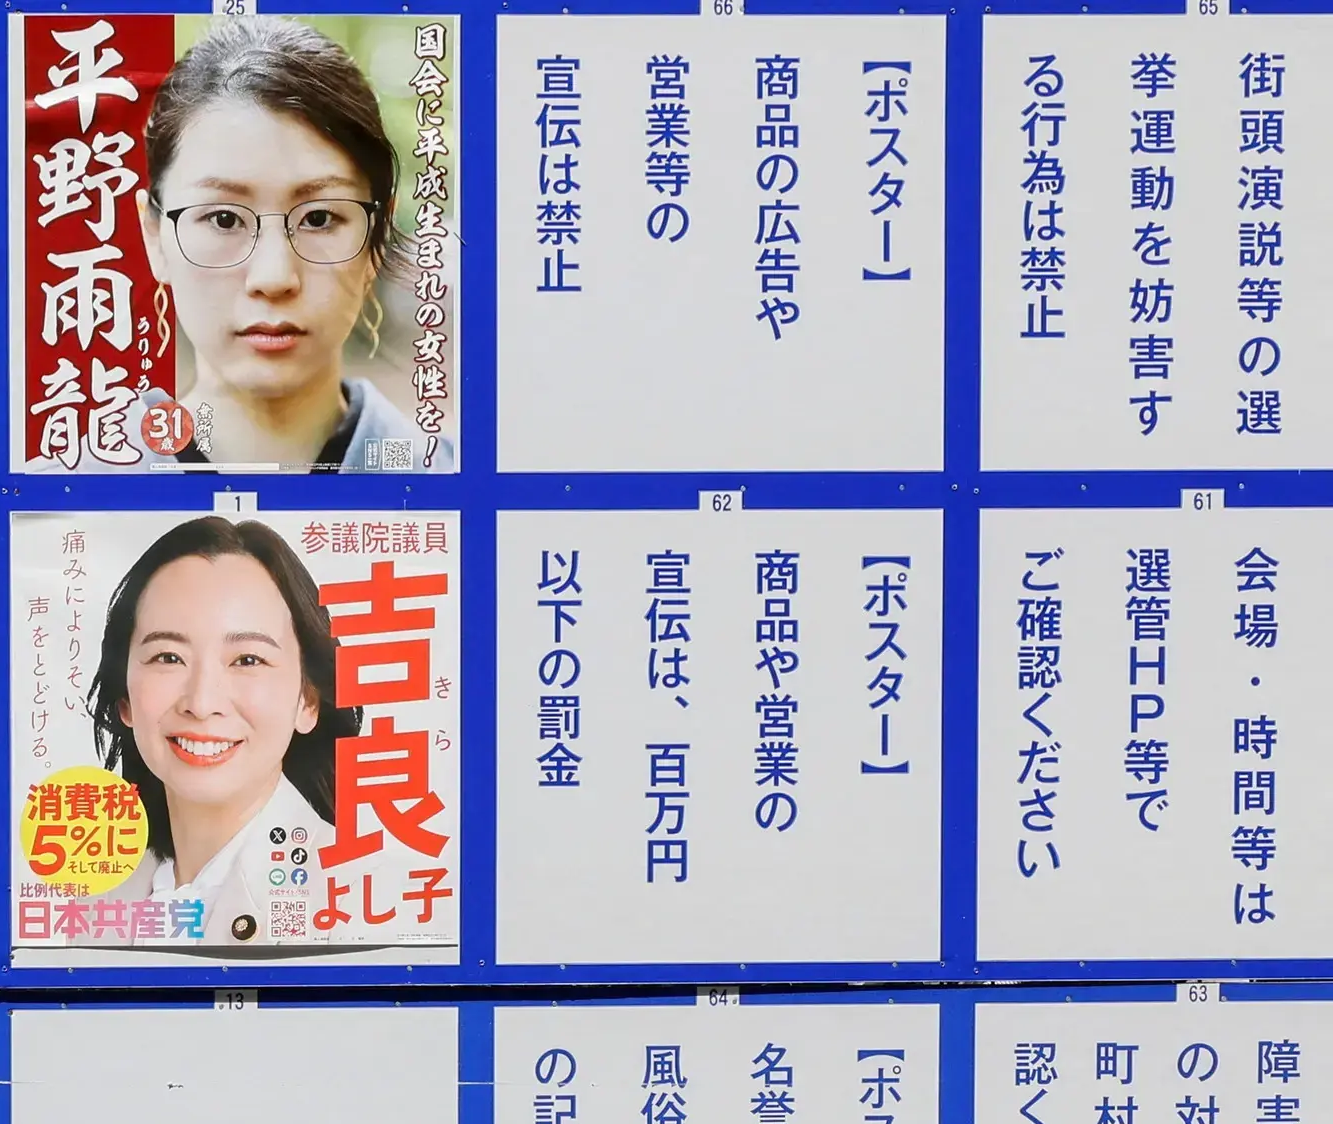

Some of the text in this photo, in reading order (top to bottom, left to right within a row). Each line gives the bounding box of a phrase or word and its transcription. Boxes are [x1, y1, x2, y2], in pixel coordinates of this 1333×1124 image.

[226, 0, 245, 15] 25
[714, 0, 733, 15] 66
[1199, 0, 1218, 15] 65
[535, 55, 582, 294] 宣伝は禁止
[645, 55, 691, 242] 営業等の
[862, 60, 912, 282] 【ポスター】
[754, 56, 801, 341] 商品の広告や
[1020, 55, 1067, 340] る行為は禁止
[31, 19, 143, 470] 平野雨龍
[412, 23, 447, 467] 国会に平成生まれの女性を!
[1129, 52, 1177, 437] 挙運動を妨害す
[1236, 54, 1285, 435] 街頭演説等の選
[137, 317, 152, 393] うりゅう
[149, 408, 183, 439] 31
[160, 438, 175, 451] 歳
[196, 403, 213, 453] 無所属
[235, 496, 240, 512] 1
[301, 522, 449, 554] 参議院議員
[712, 494, 732, 511] 62
[1193, 493, 1212, 510] 61
[61, 529, 88, 720] 痛みによりそい、
[27, 596, 52, 769] 声をとどける。
[537, 549, 582, 789] 以下の罰金
[754, 550, 800, 832] 商品や営業の
[861, 555, 911, 776] 【ポスター】
[317, 561, 451, 870] 吉良
[434, 675, 453, 752] きら
[1016, 547, 1063, 878] ご確認ください
[1232, 547, 1279, 925] 会場・時間等は
[27, 783, 141, 822] 消費税
[20, 882, 90, 898] 比例代表は
[67, 860, 135, 875] そして廃止へ
[312, 867, 454, 931] よし子
[18, 899, 206, 940] 日本共産党
[226, 993, 244, 1010] 13
[709, 989, 728, 1006] 64
[1189, 985, 1208, 1002] 63
